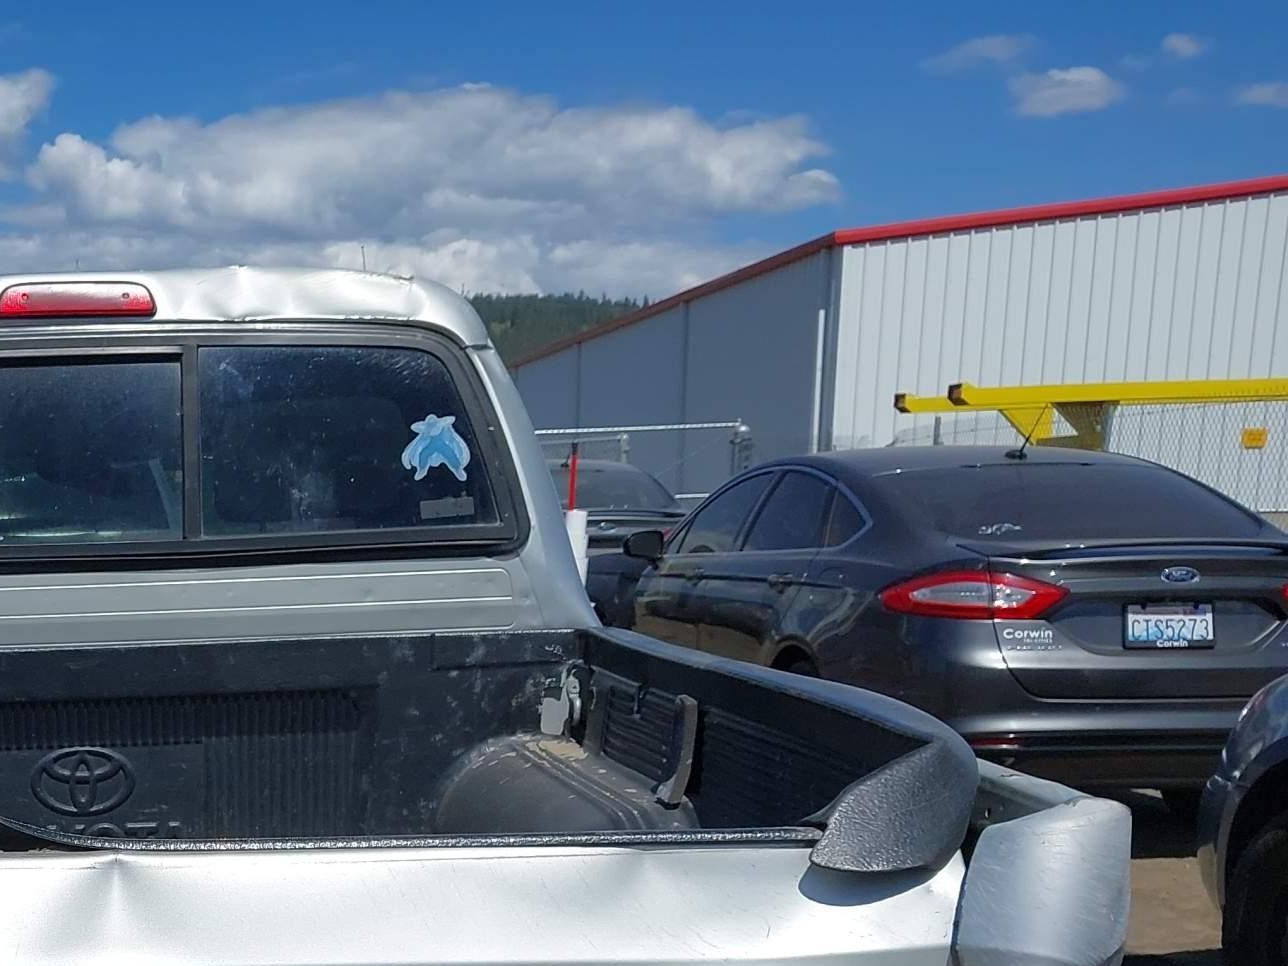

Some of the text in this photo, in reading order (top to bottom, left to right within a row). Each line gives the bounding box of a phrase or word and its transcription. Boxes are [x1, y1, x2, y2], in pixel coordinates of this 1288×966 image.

[1003, 627, 1053, 639] Corwin
[1131, 618, 1210, 641] CTS5273
[1156, 639, 1189, 648] Corwin
